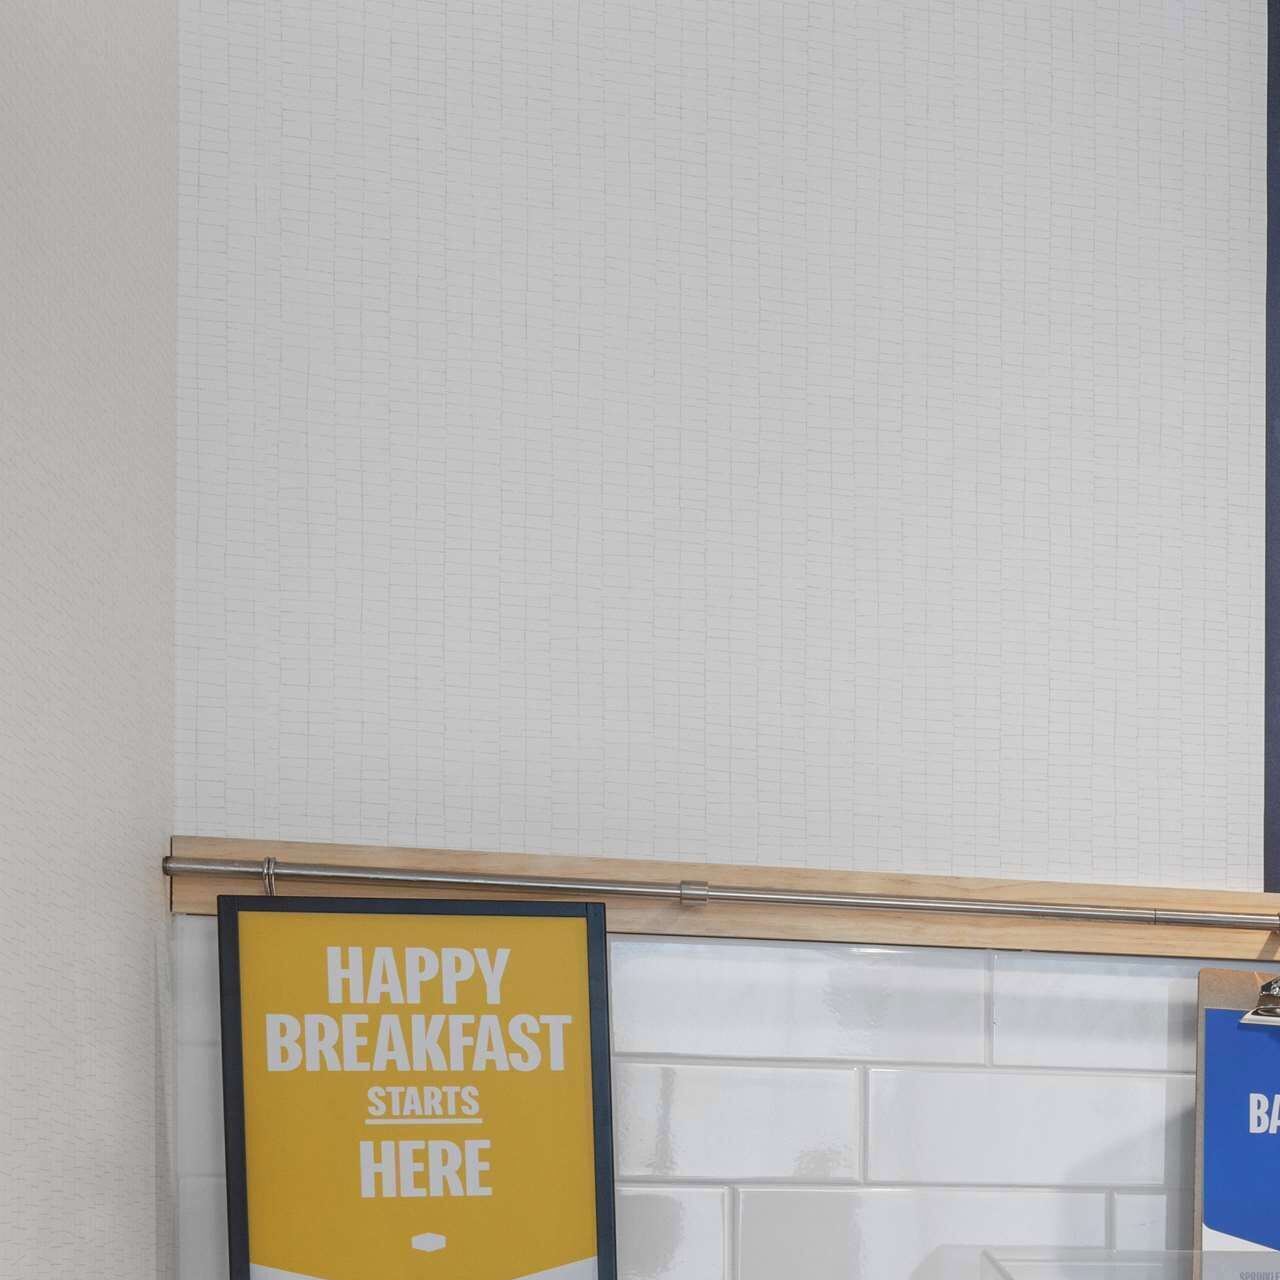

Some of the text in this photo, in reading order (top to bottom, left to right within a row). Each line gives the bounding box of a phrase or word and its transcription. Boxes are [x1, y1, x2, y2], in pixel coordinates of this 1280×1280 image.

[326, 946, 511, 1004] HAPPY
[265, 1014, 572, 1072] BREAKFAST
[367, 1086, 480, 1116] STARTS
[359, 1140, 493, 1198] HERE
